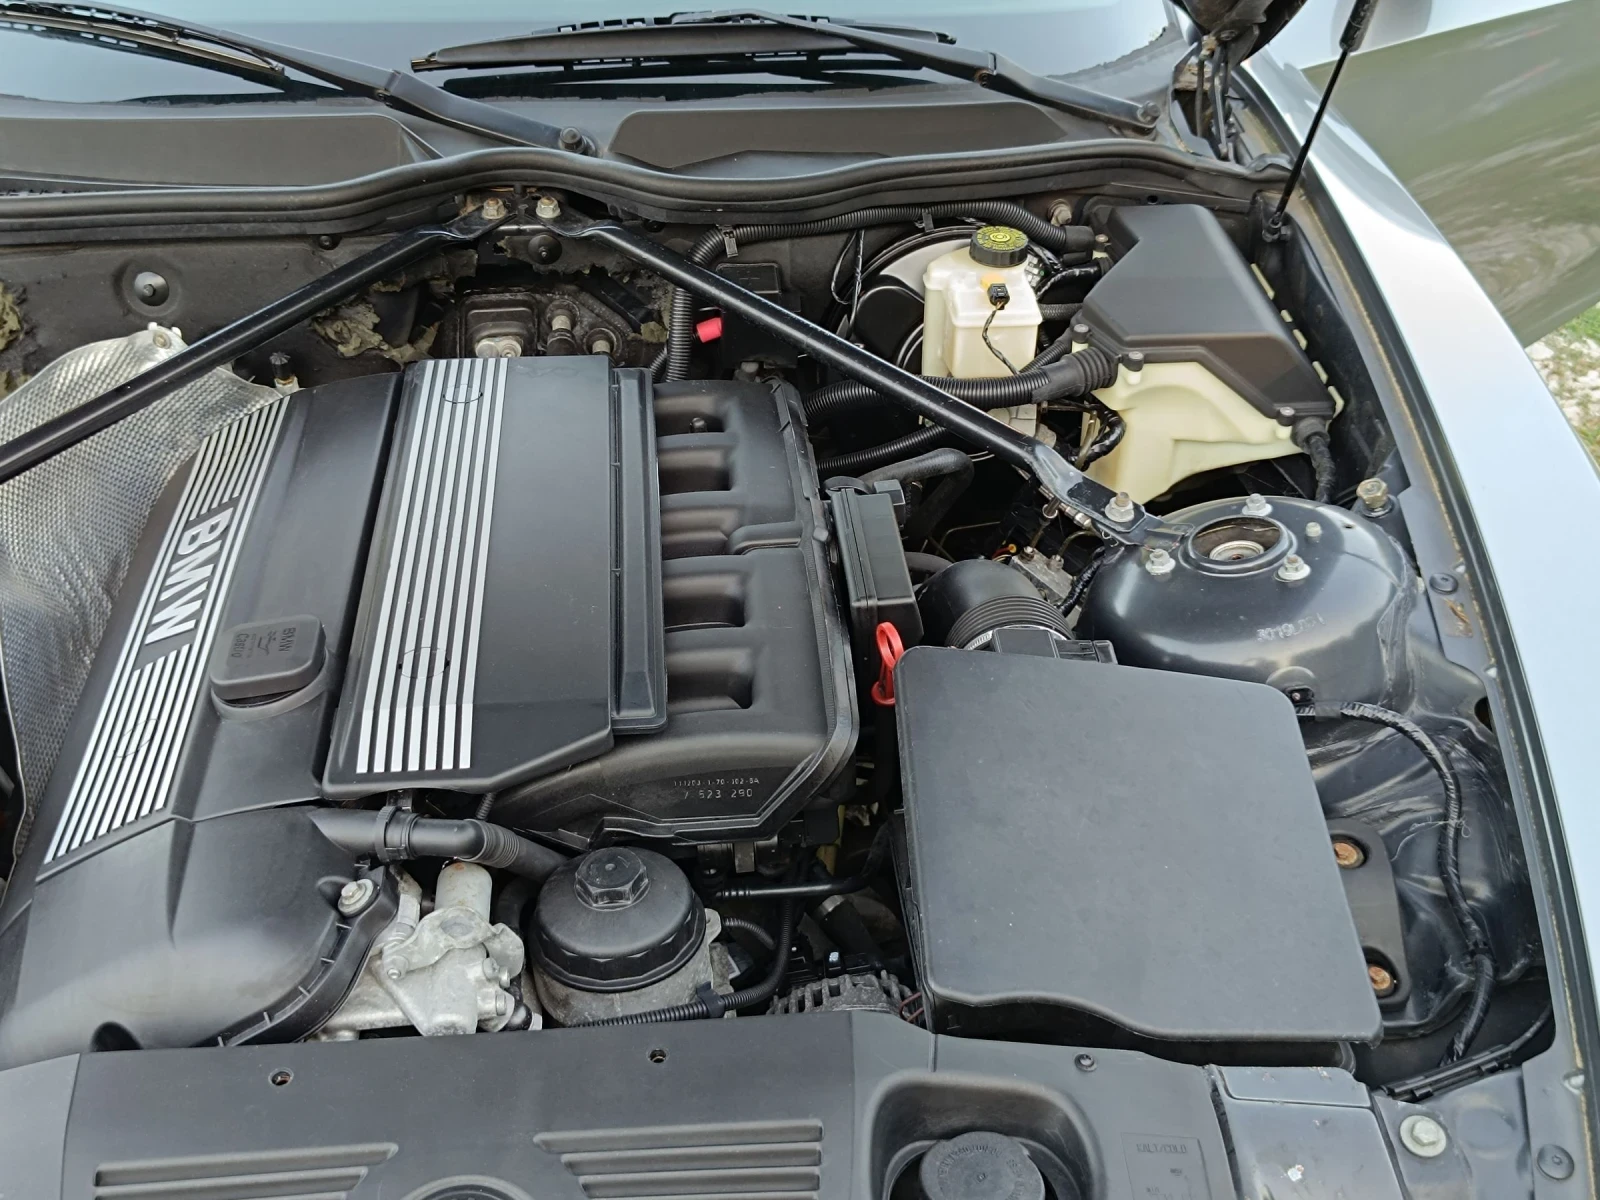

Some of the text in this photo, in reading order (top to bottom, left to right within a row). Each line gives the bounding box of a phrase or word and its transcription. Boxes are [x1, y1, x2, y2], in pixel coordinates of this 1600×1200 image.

[144, 507, 234, 645] BMW
[278, 627, 297, 652] BMW
[699, 789, 722, 799] 523
[731, 788, 753, 798] 290
